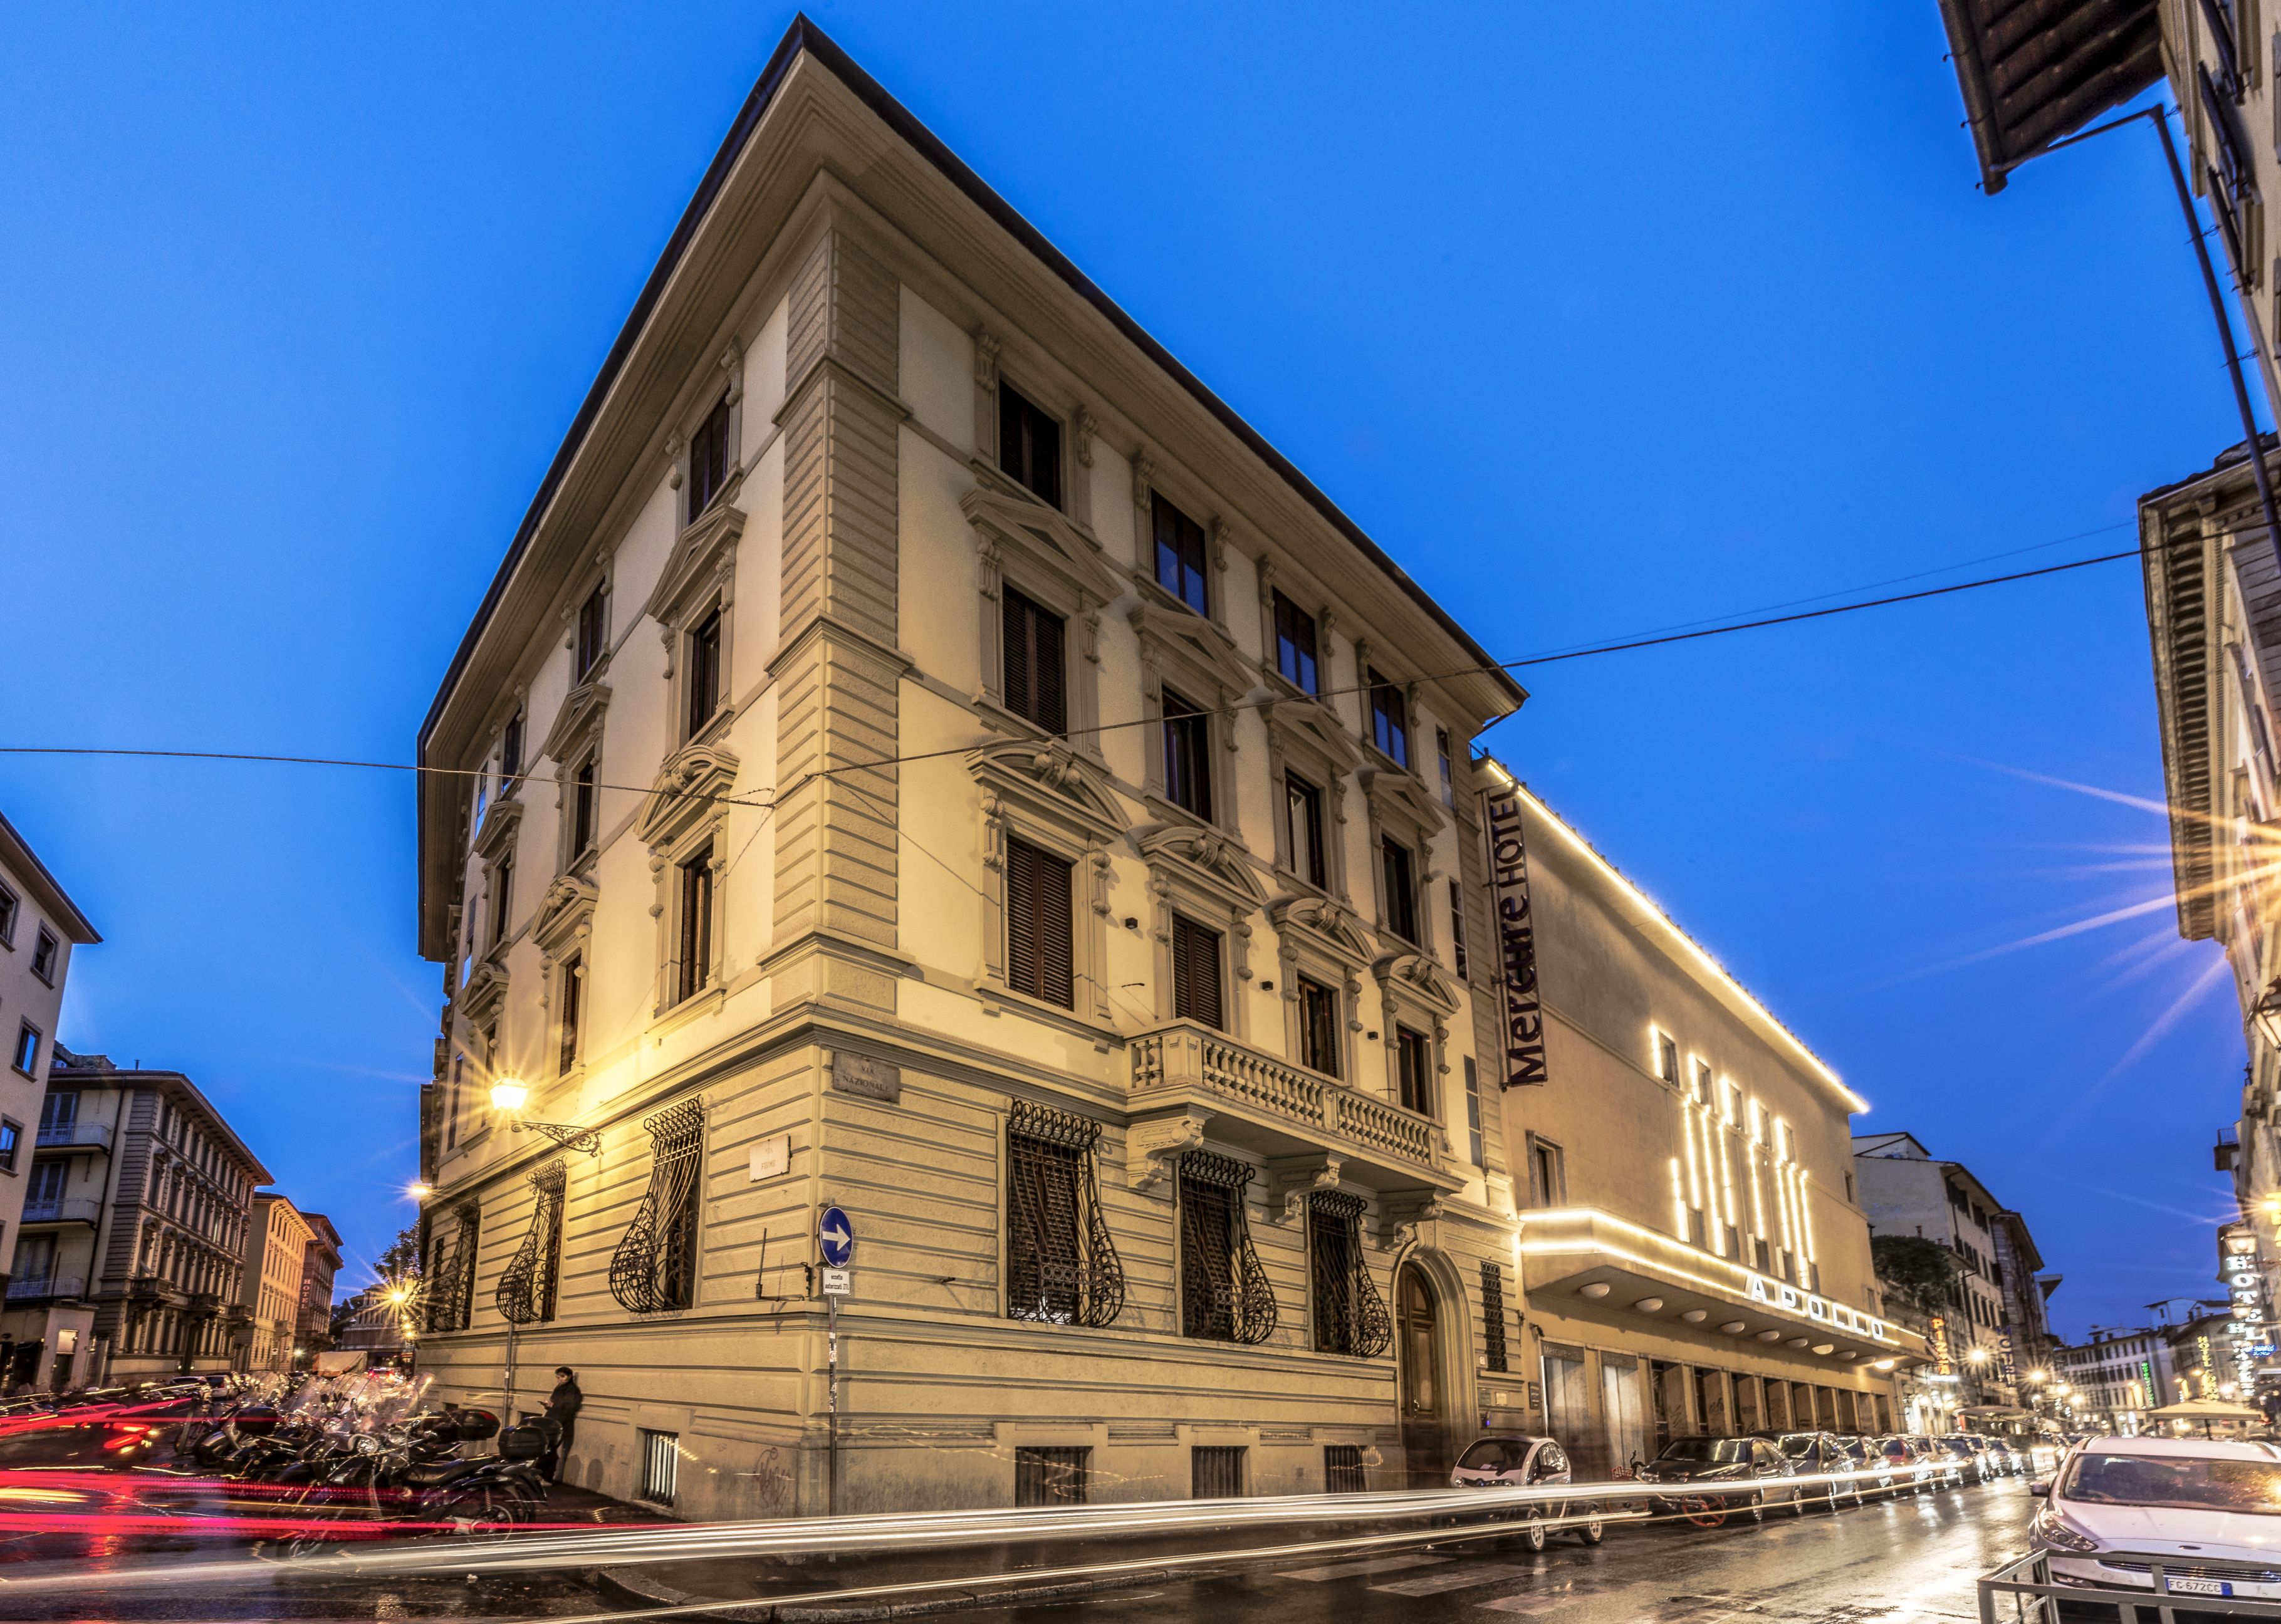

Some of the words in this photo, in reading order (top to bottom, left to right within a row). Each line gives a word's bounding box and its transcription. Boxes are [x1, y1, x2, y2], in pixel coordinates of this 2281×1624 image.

[1489, 779, 1527, 888] HOTEL
[1500, 894, 1545, 1085] Mercure
[842, 1075, 890, 1093] NAZIONALE
[861, 1066, 874, 1075] VIA
[301, 1279, 311, 1309] HOTEL
[1750, 1274, 1884, 1341] APOLLO
[2197, 1336, 2212, 1367] HOTEL
